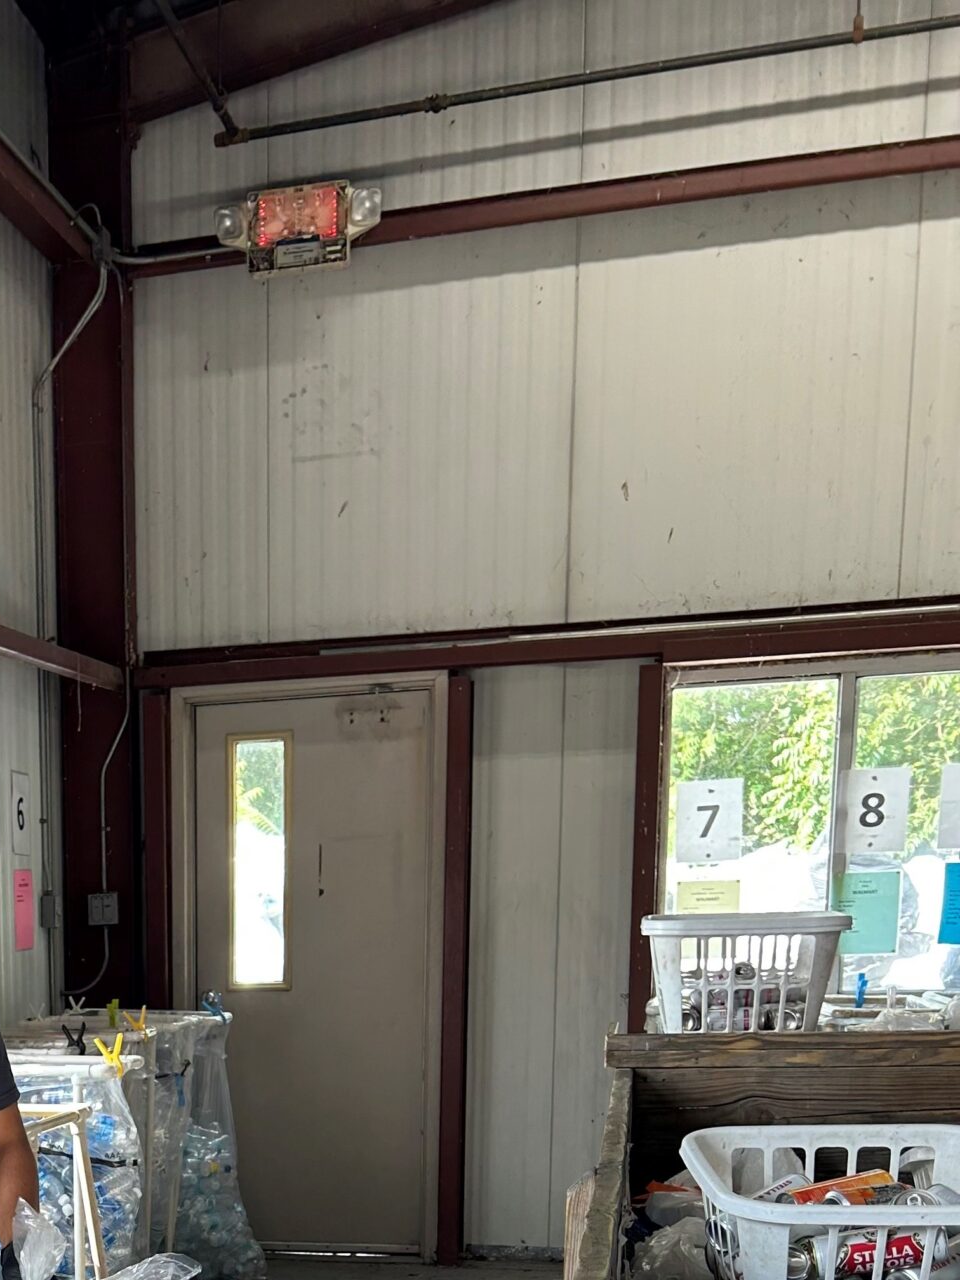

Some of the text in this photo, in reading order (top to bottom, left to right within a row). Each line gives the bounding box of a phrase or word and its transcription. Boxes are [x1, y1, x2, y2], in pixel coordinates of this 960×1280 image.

[16, 797, 26, 831] 6
[696, 804, 720, 839] 7
[859, 792, 886, 828] 8
